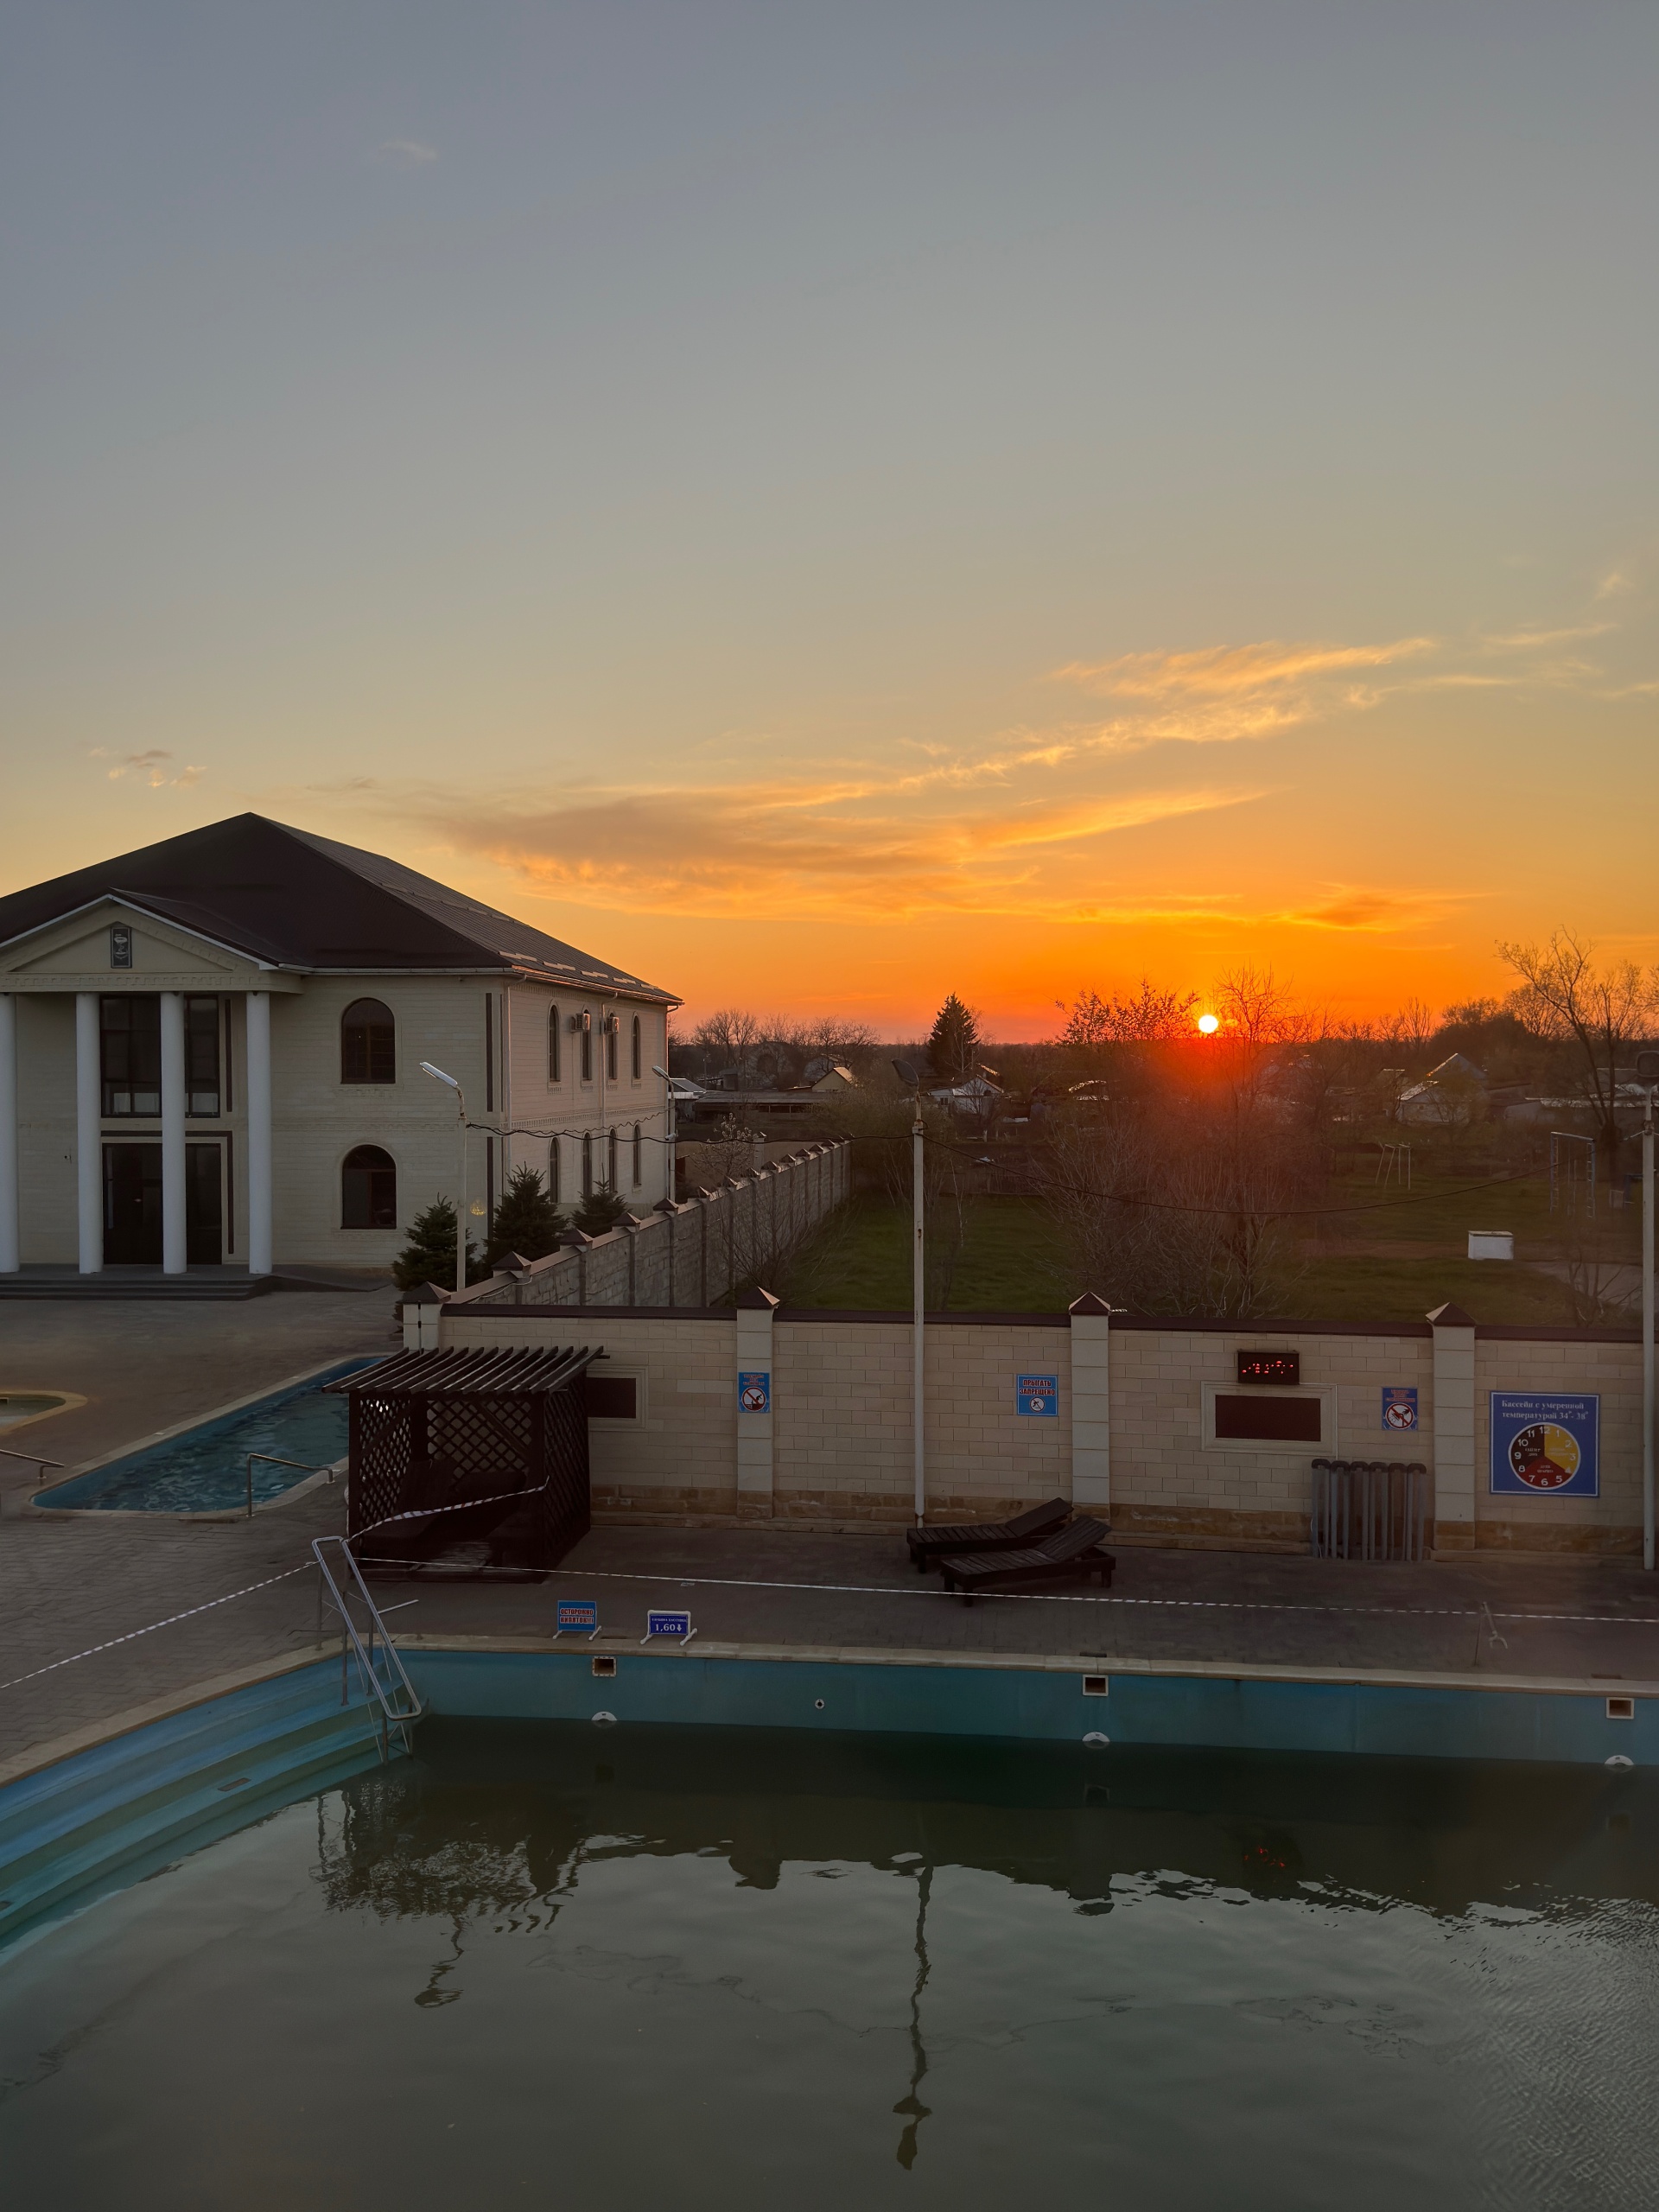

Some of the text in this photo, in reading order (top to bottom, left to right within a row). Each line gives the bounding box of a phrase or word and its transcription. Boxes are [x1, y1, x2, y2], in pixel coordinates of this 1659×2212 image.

[1502, 1400, 1533, 1408] Бассейн
[1541, 1402, 1585, 1410] умеренной
[1502, 1412, 1557, 1421] температурой
[1539, 1426, 1550, 1434] 12
